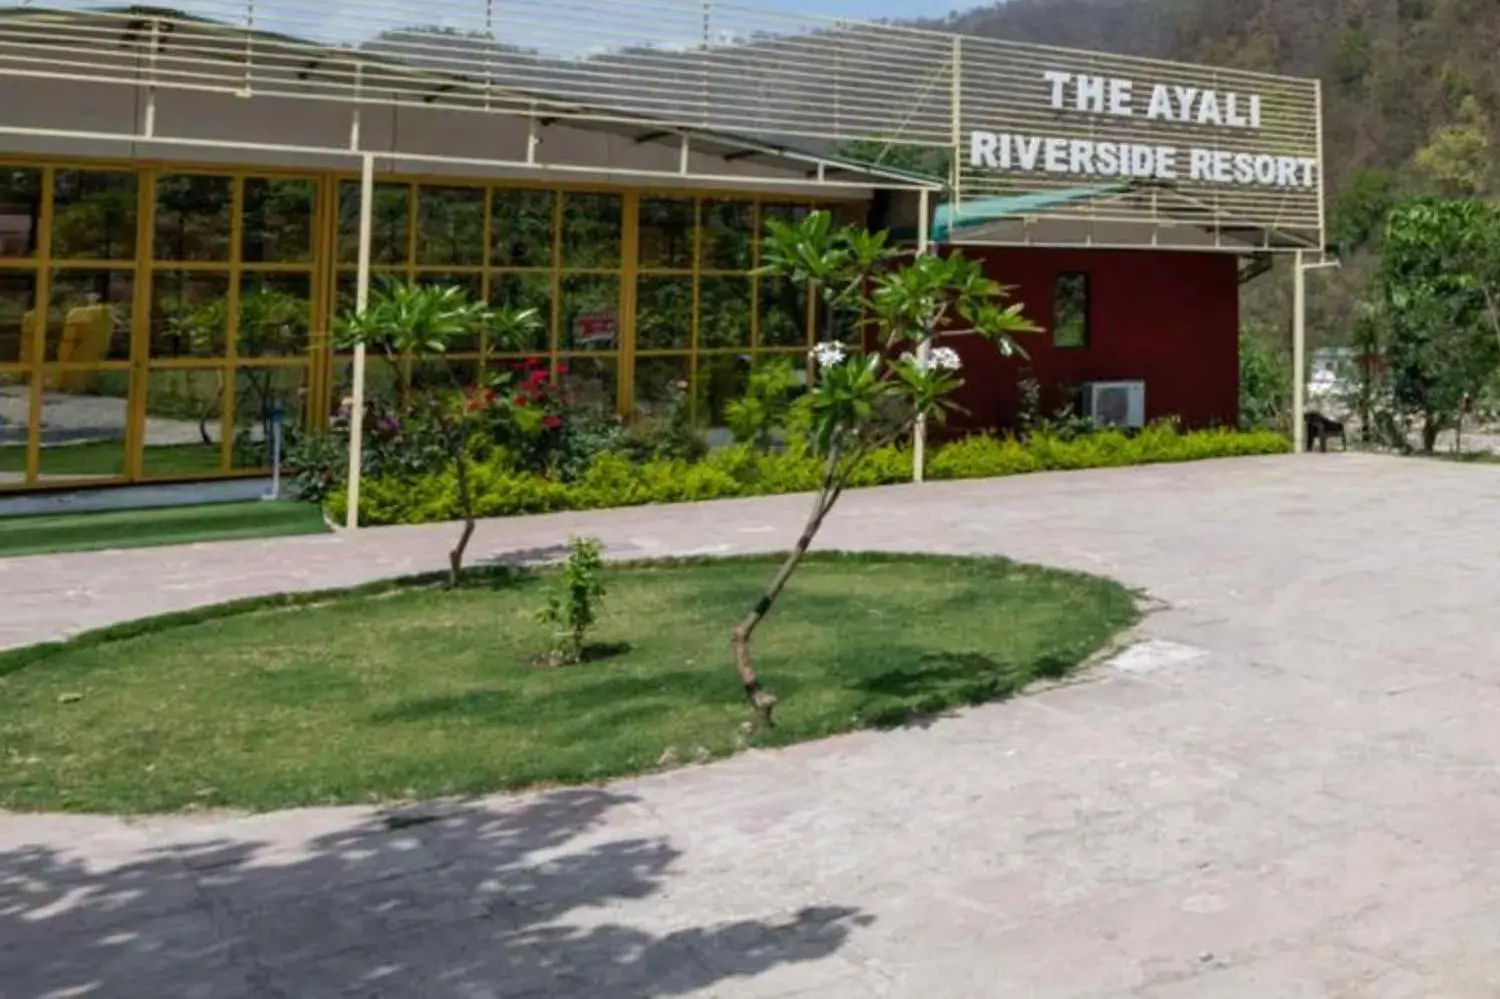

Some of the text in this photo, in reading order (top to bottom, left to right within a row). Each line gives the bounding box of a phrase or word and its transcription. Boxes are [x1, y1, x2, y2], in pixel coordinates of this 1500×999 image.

[1044, 71, 1261, 128] THE AYALI
[970, 131, 1318, 188] RIVERSIDE RESORT
